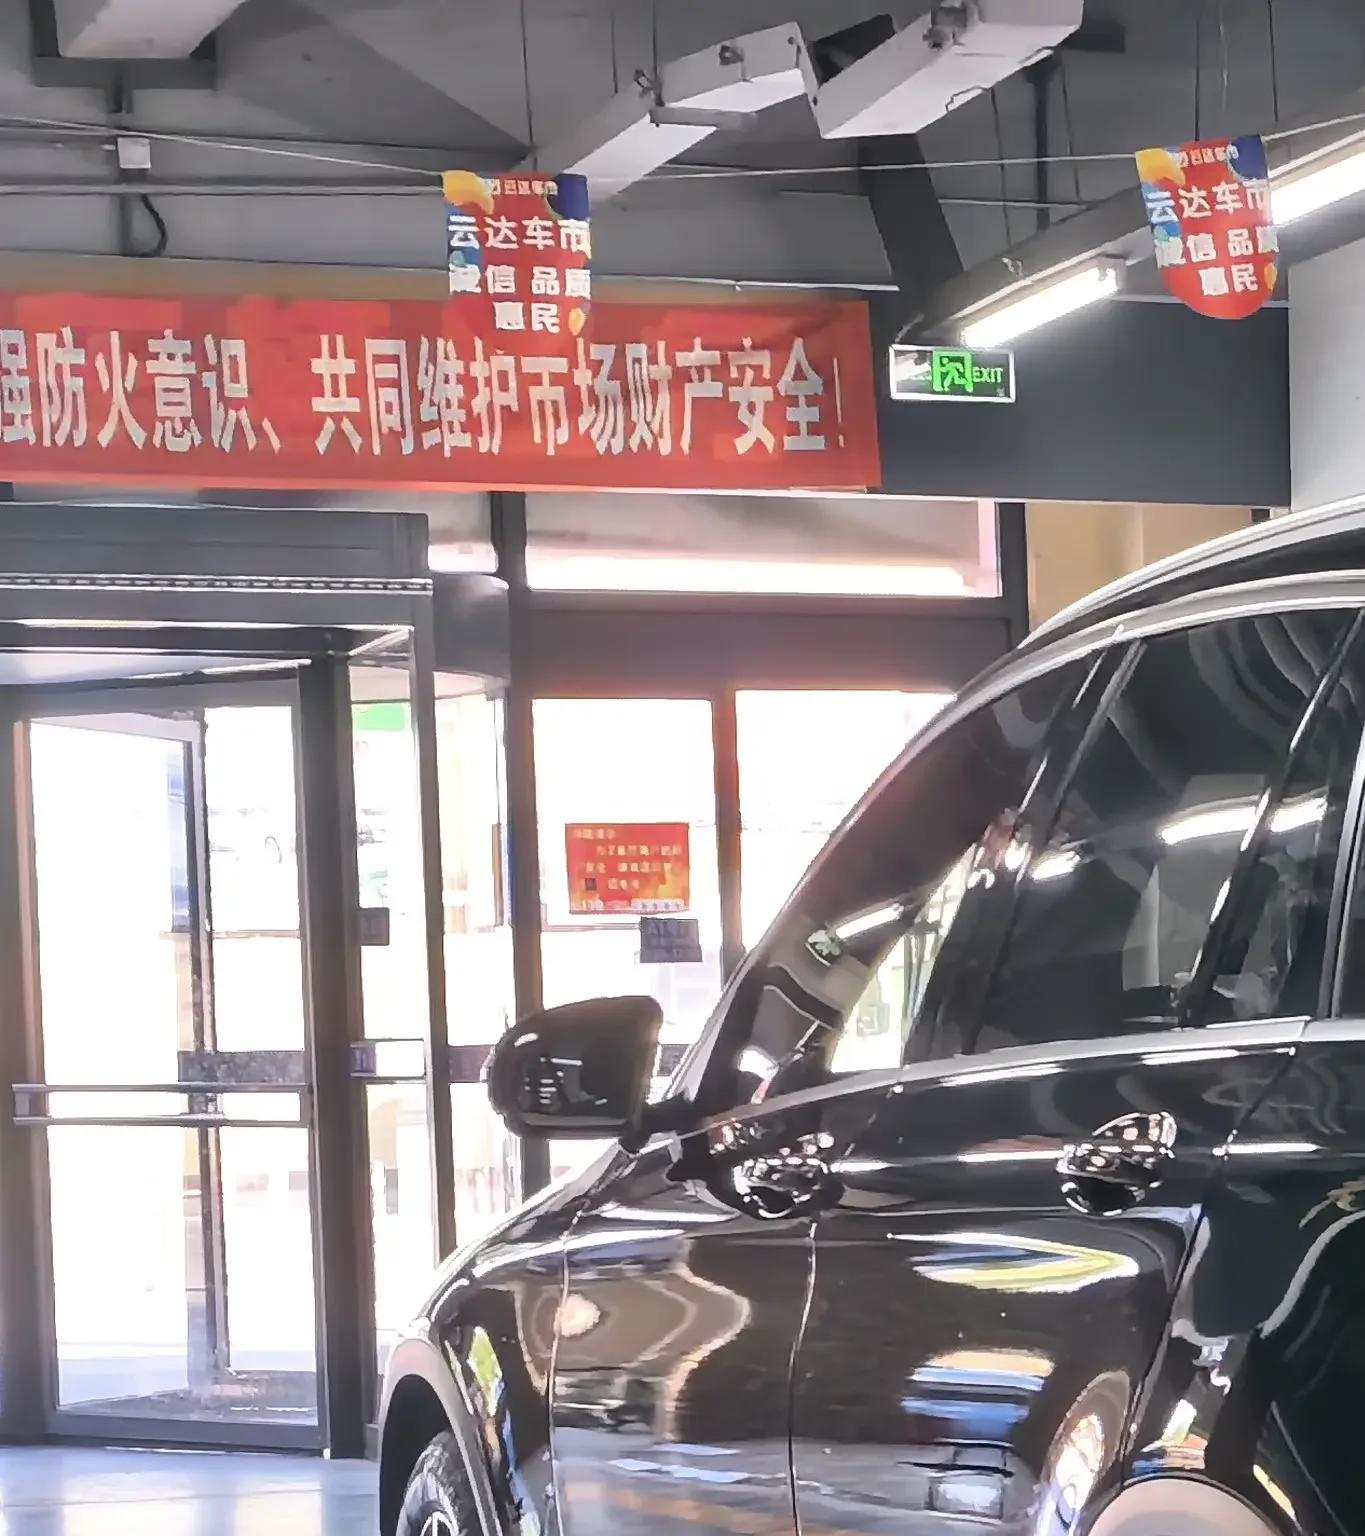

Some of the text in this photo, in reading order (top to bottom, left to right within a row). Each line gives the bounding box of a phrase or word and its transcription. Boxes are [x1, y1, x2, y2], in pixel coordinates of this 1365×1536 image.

[448, 214, 592, 259] 云达车市
[972, 366, 1003, 383] EXIT
